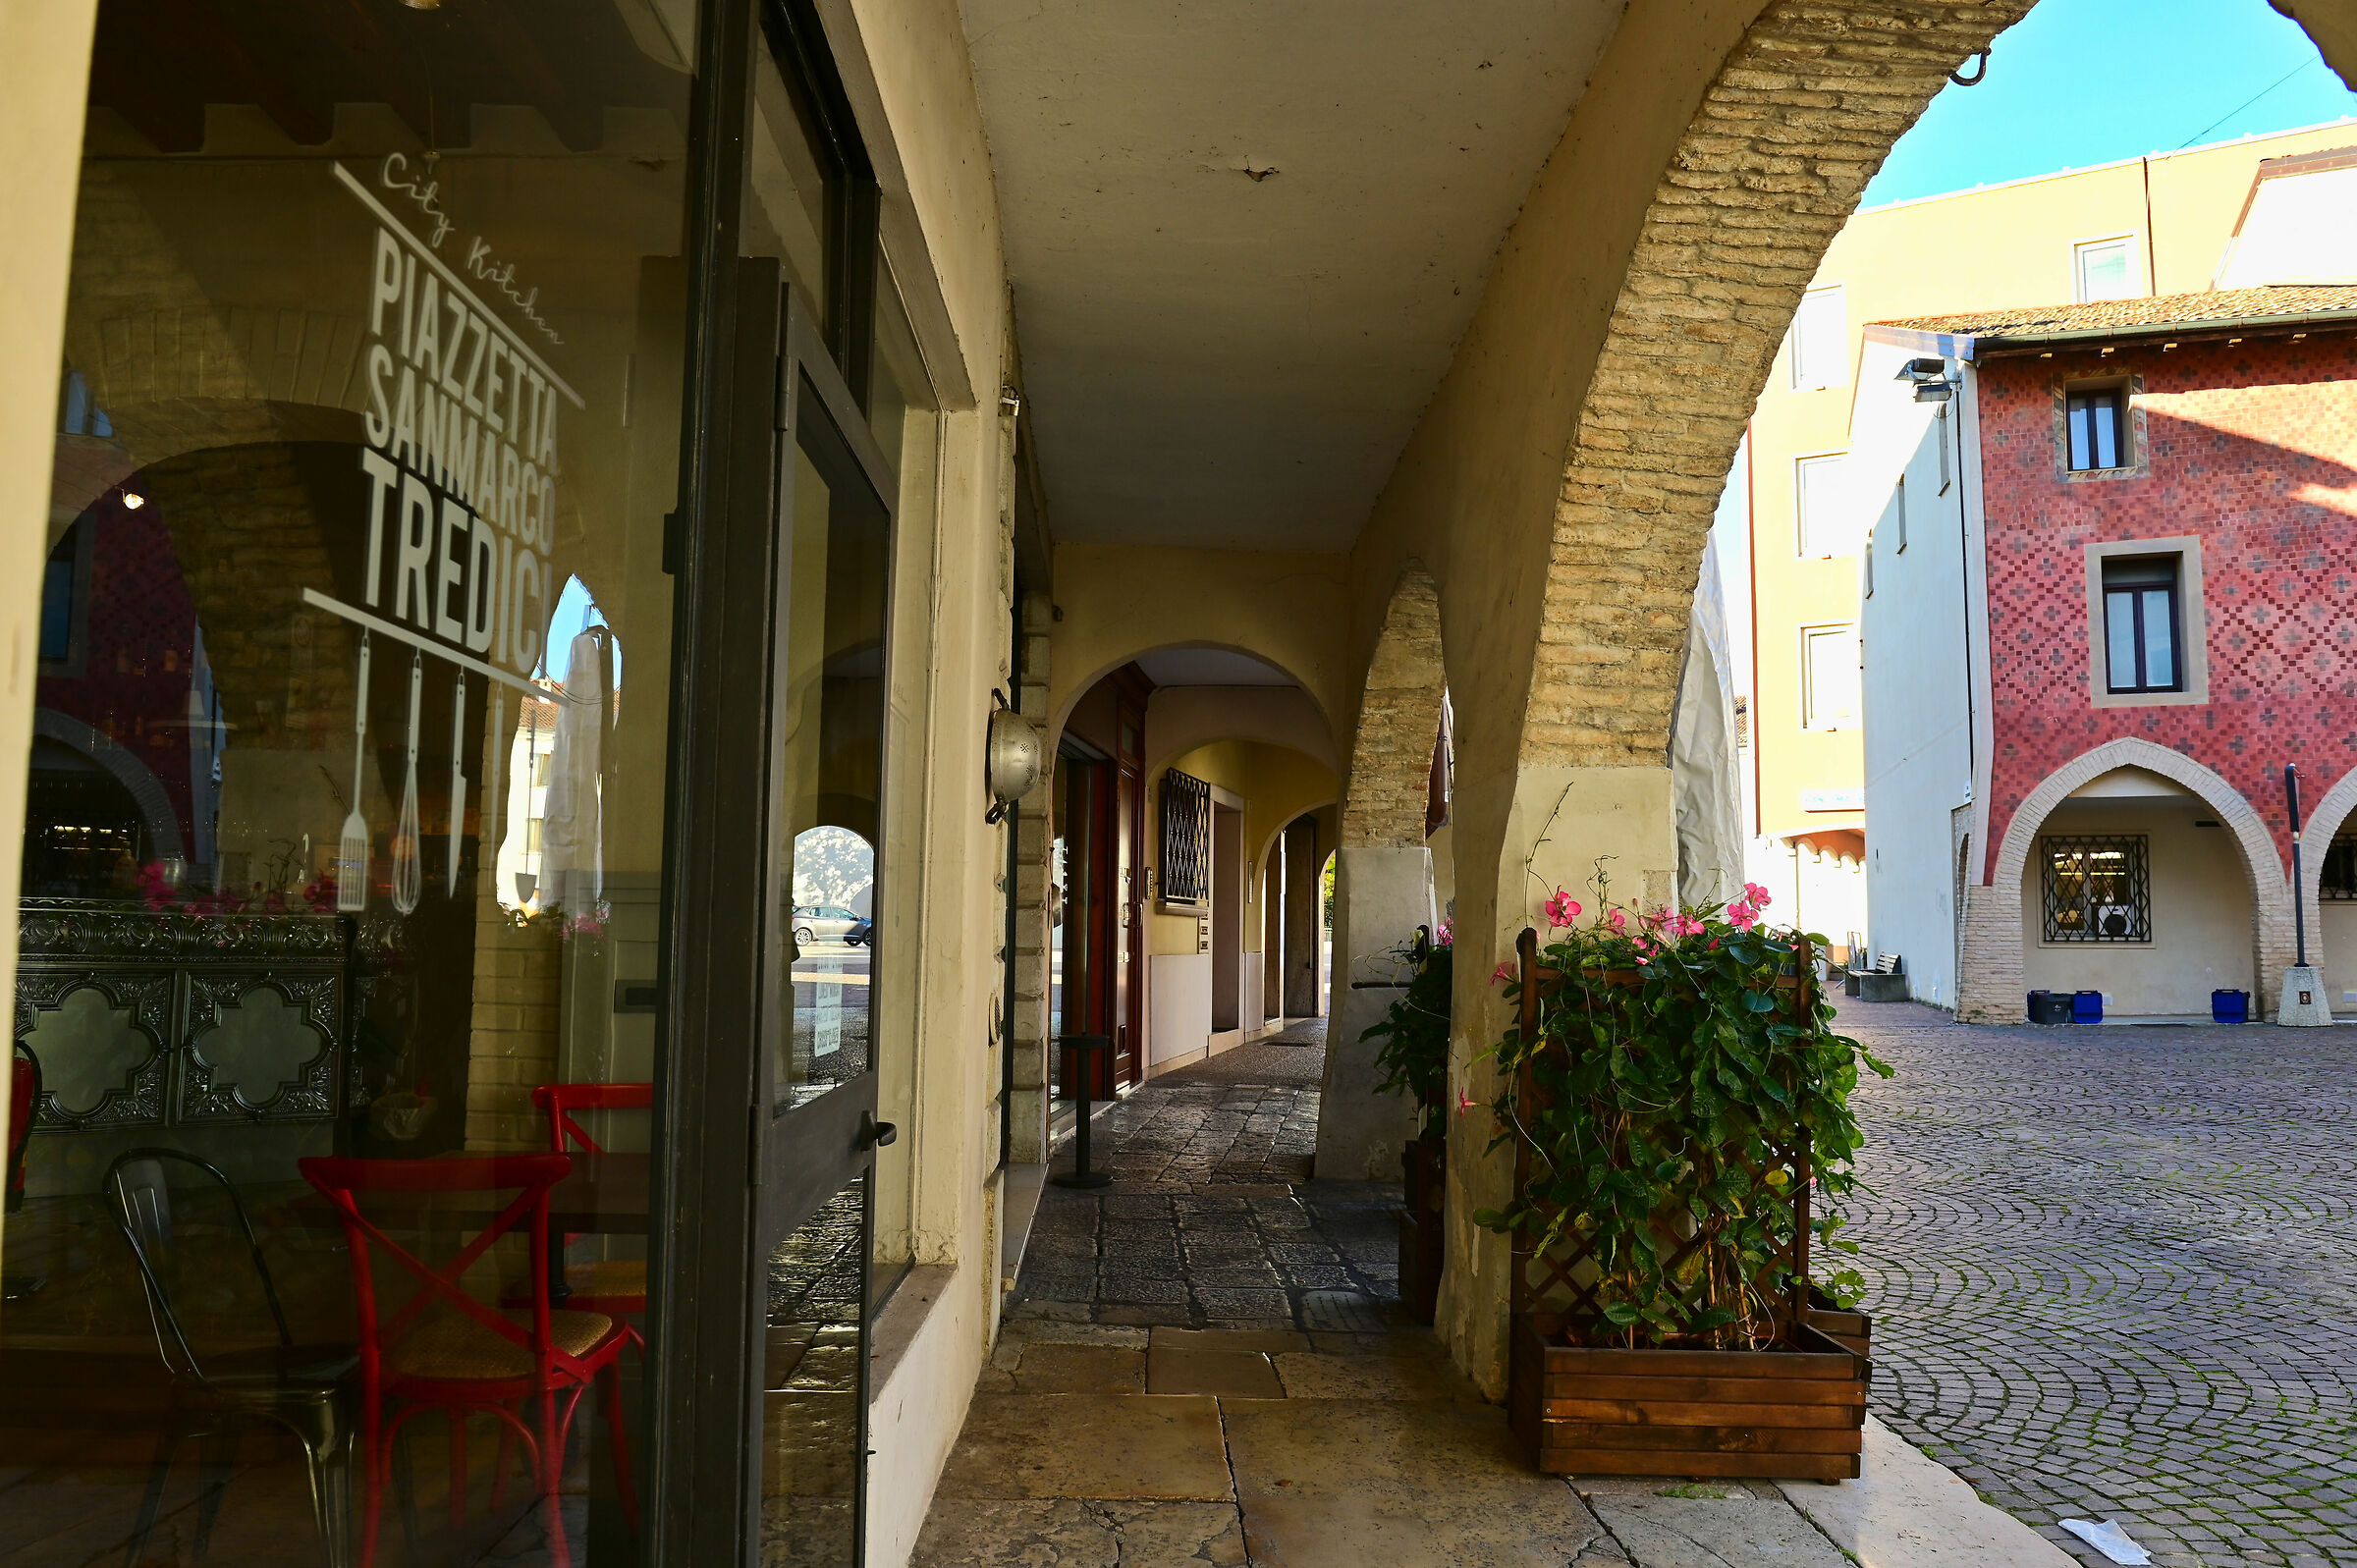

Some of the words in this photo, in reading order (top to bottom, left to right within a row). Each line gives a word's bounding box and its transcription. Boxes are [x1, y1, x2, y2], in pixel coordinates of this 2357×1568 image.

[372, 226, 558, 475] PIAZZETTA
[384, 152, 455, 248] City
[467, 236, 565, 345] Kitchen
[361, 447, 553, 679] TREDICI
